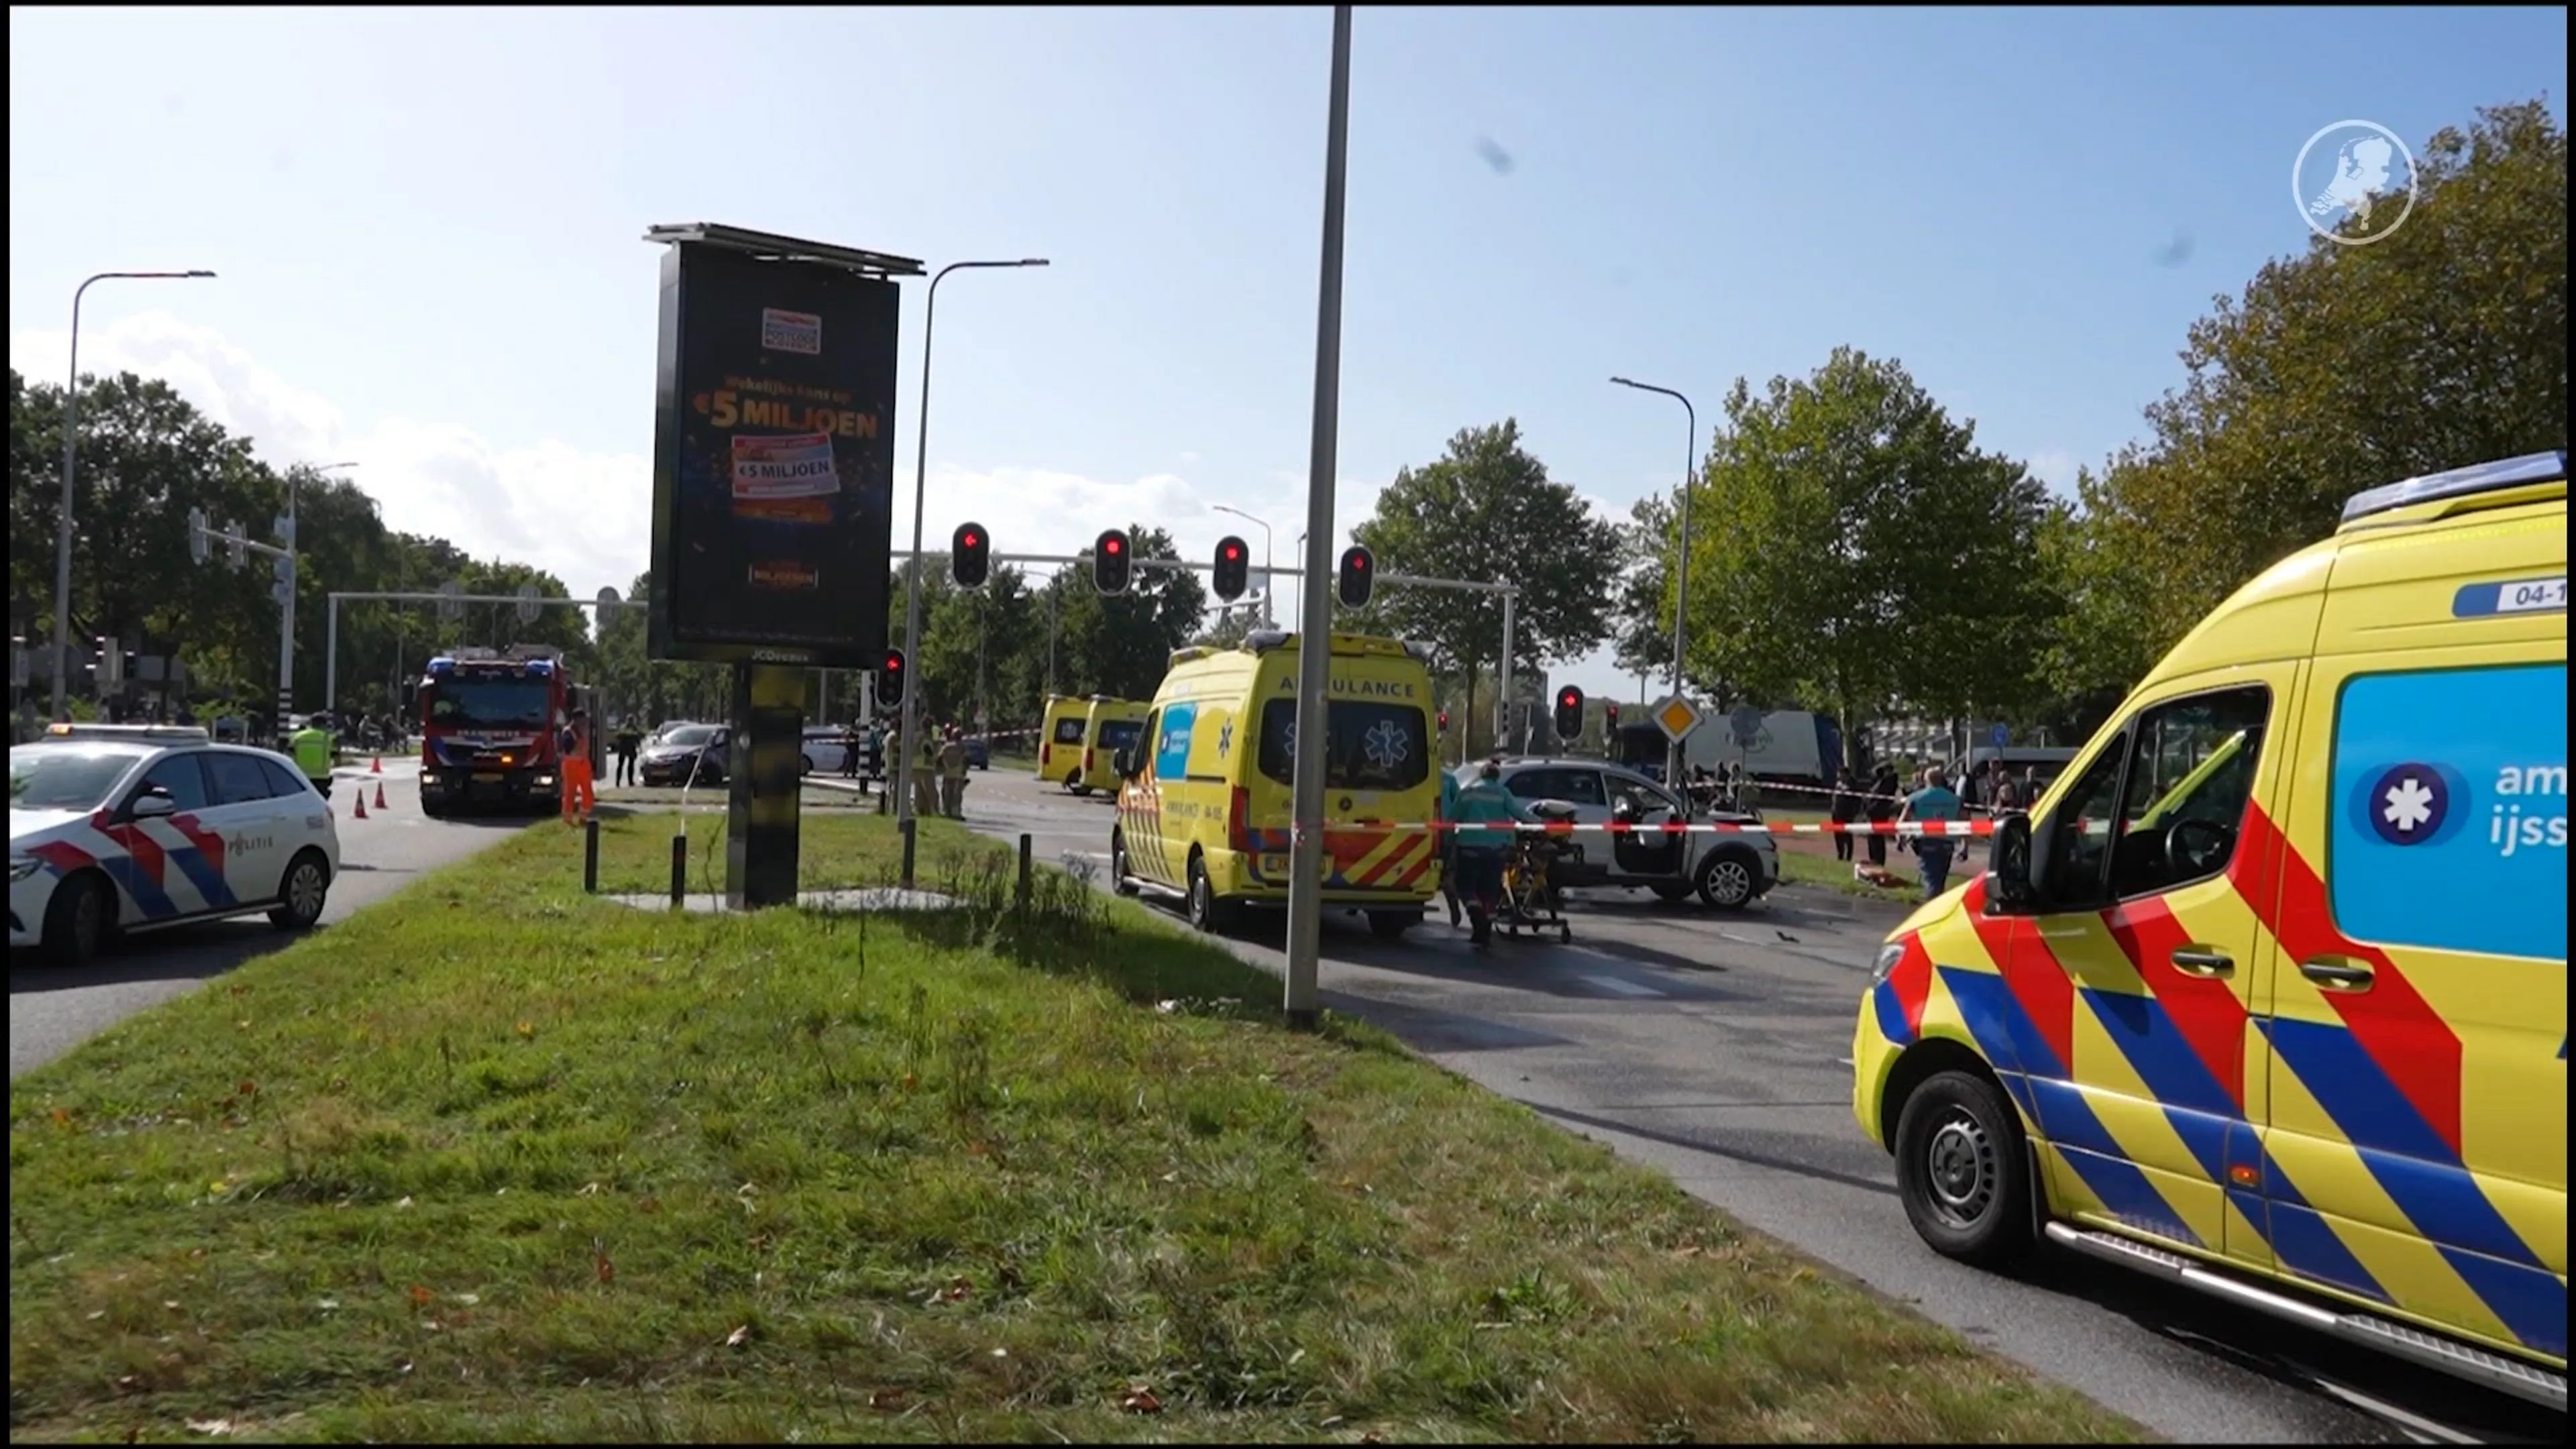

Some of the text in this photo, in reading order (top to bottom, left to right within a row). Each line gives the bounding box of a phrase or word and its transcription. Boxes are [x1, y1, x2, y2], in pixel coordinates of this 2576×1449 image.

[743, 399, 877, 438] MILJOEN
[761, 461, 829, 478] MILJOEN
[1280, 677, 1414, 697] AULANCE
[2496, 765, 2567, 796] am
[2490, 804, 2567, 857] ijss
